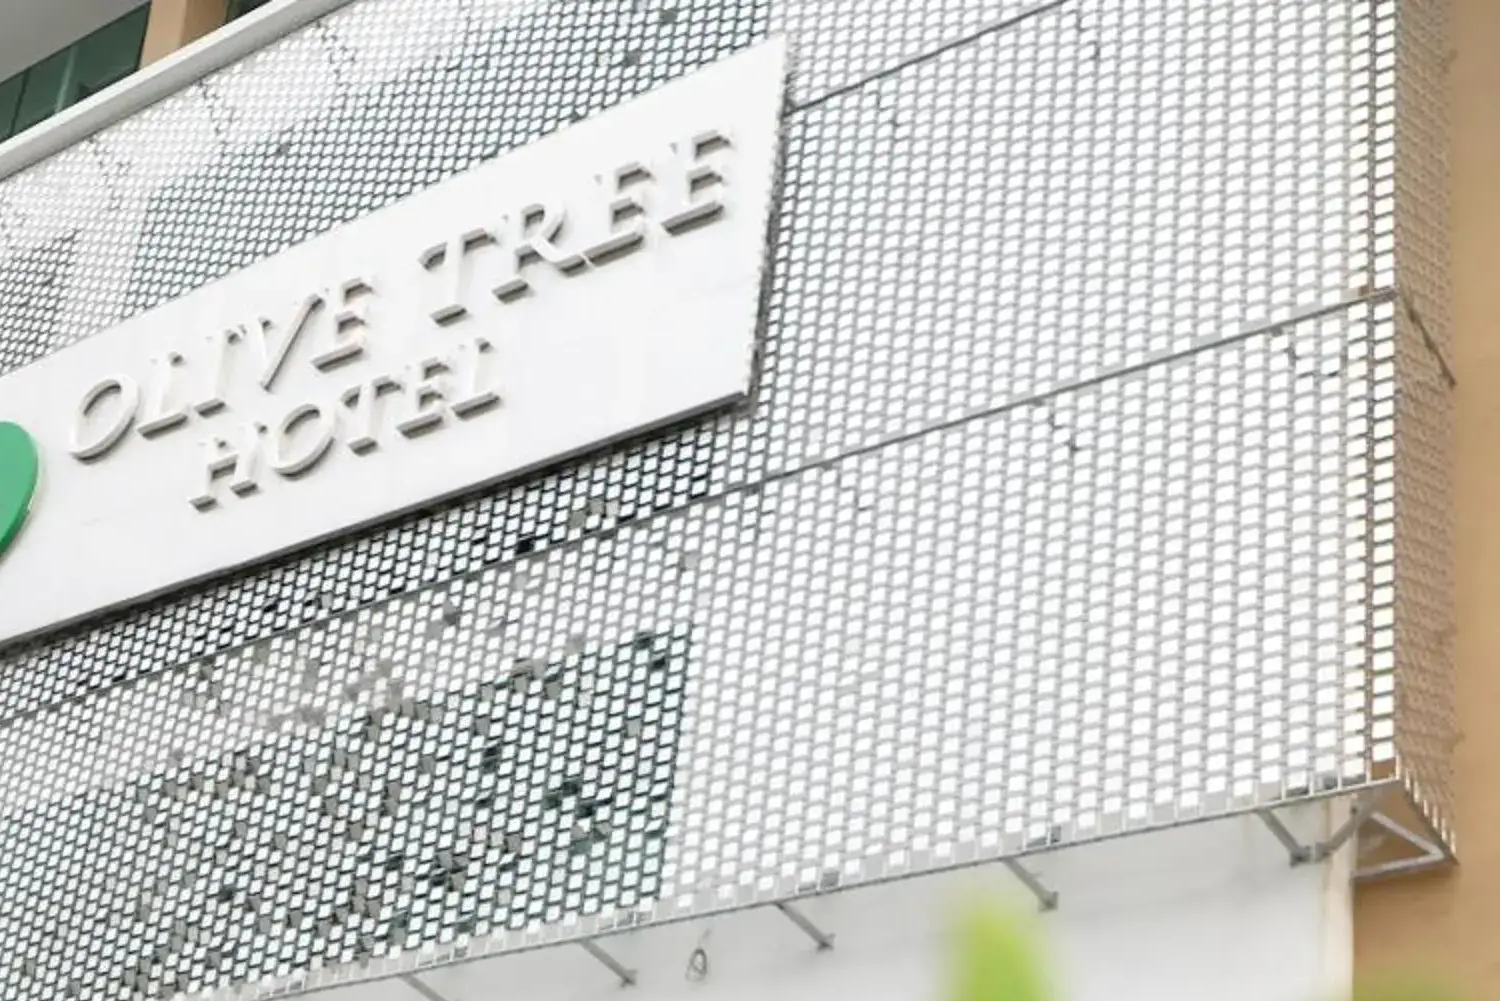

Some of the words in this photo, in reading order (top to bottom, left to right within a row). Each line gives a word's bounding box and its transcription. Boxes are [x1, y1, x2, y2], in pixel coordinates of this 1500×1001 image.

[69, 275, 376, 463] OLIVE
[417, 127, 733, 327] TREE
[187, 336, 503, 511] HOTEL
